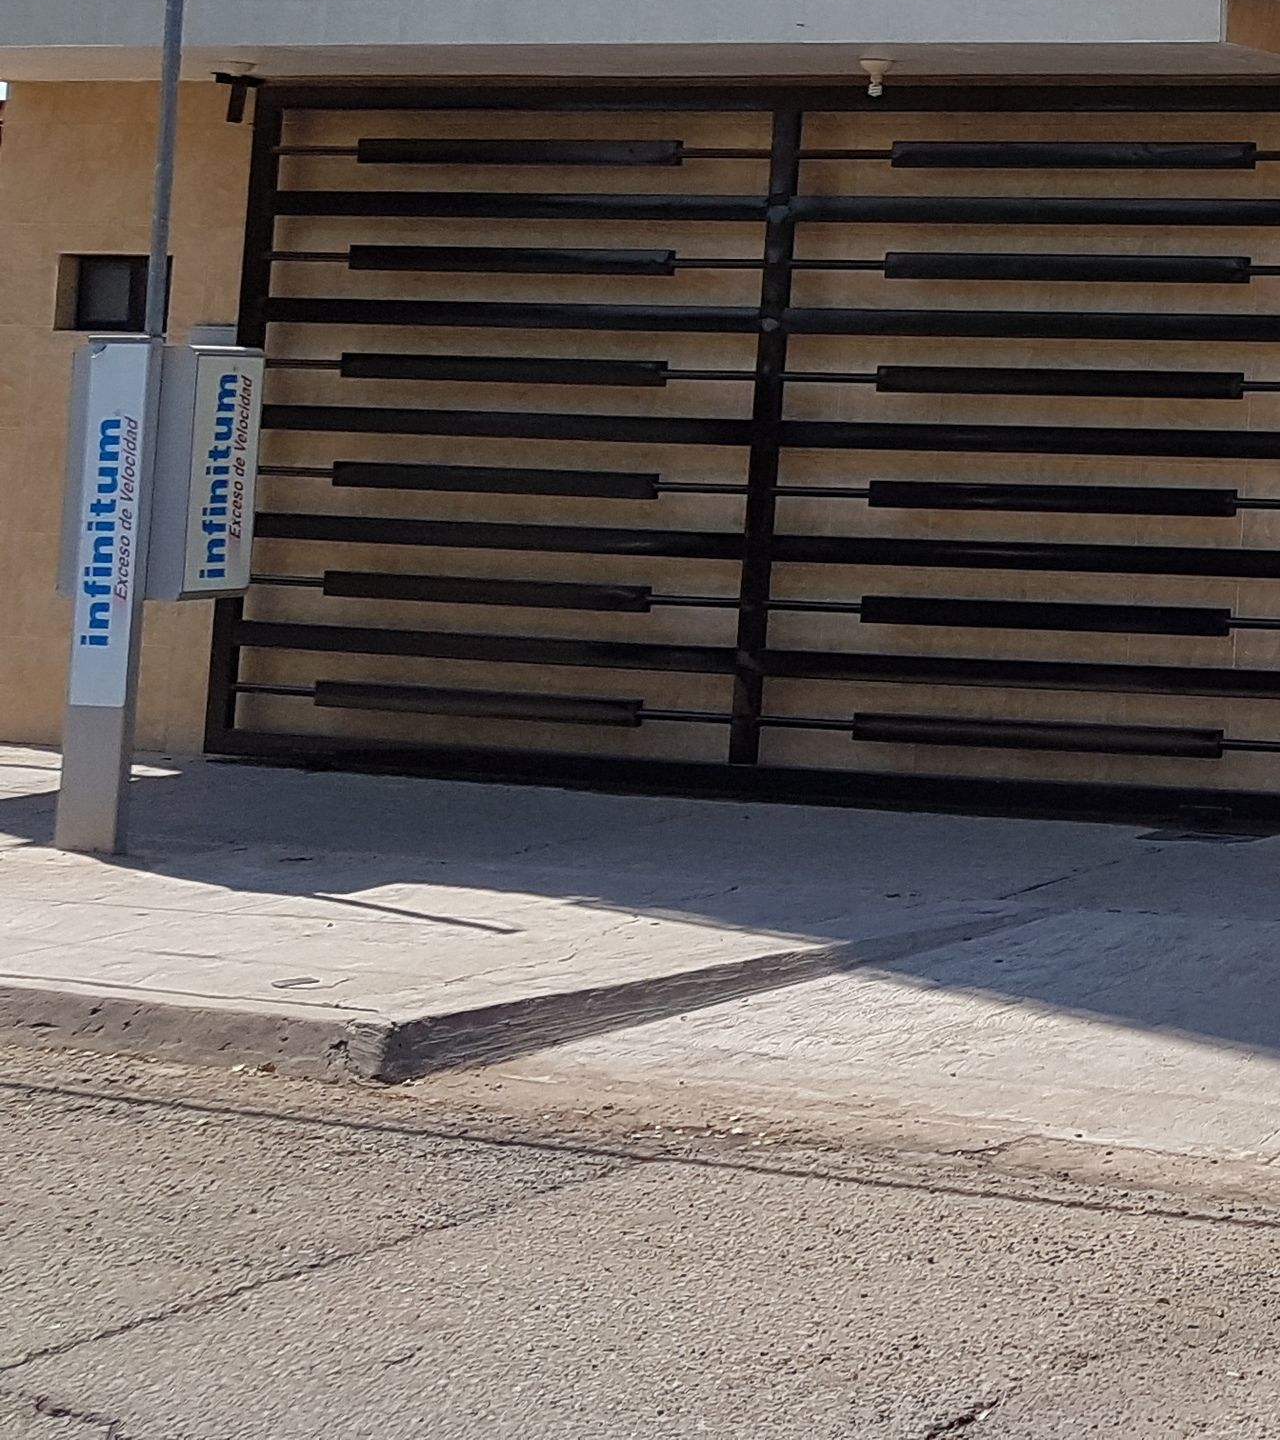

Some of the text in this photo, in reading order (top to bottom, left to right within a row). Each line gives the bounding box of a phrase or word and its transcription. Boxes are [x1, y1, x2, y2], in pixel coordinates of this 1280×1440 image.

[79, 417, 122, 648] infinitum
[113, 415, 140, 601] Exceso de Velocidad
[198, 373, 239, 580] infinitum
[228, 374, 254, 540] Exceso de Velocidad
